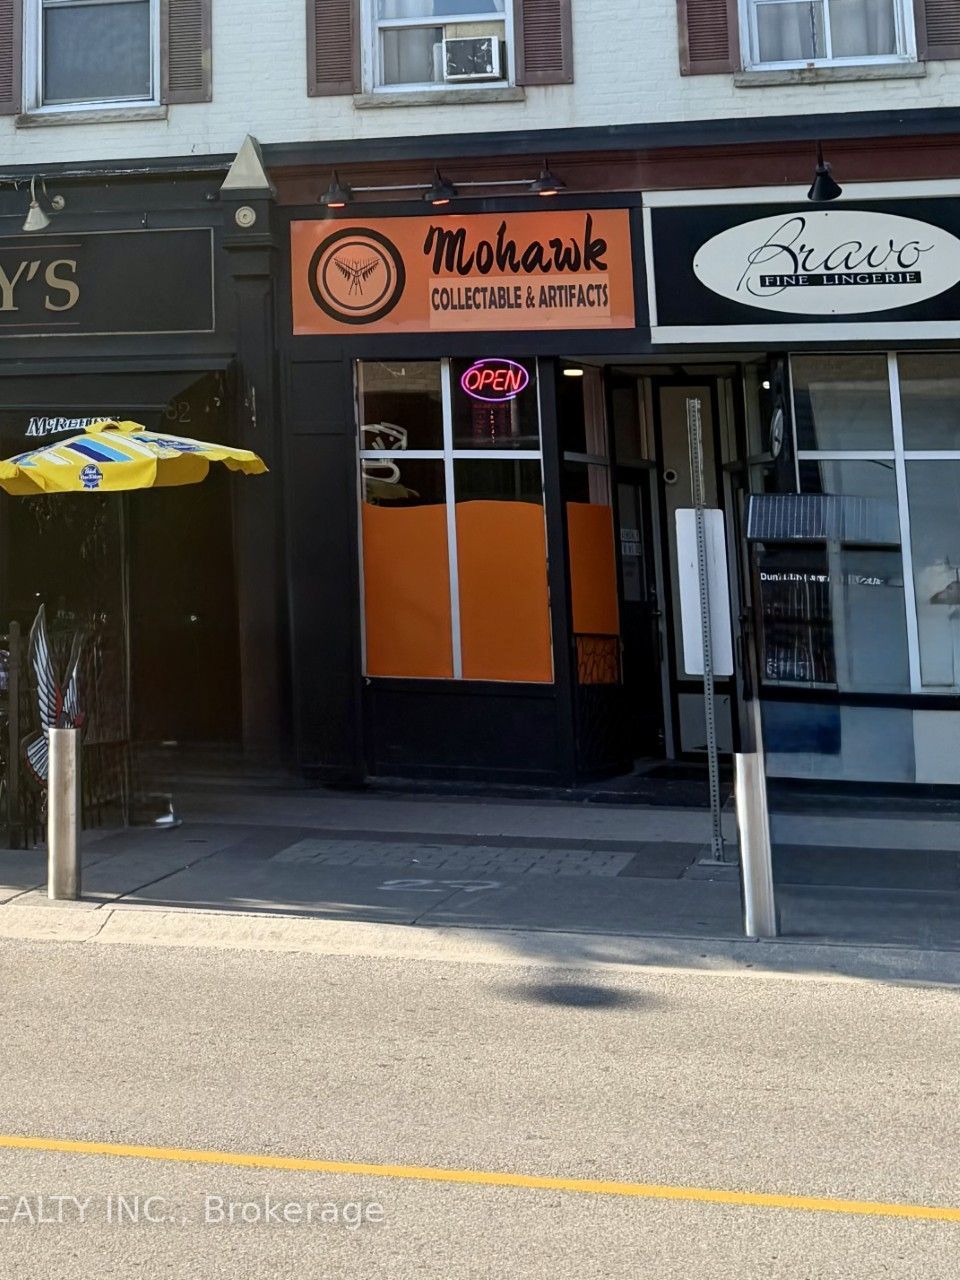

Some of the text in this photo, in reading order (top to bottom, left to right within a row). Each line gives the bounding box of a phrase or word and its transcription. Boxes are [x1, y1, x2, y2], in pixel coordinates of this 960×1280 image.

[423, 212, 608, 276] Mohawk
[736, 216, 935, 297] Bravo
[764, 272, 918, 286] FINE LINGERIE
[431, 283, 609, 311] COLLECTABLE & ARTIFACTS
[465, 369, 522, 391] OPEN
